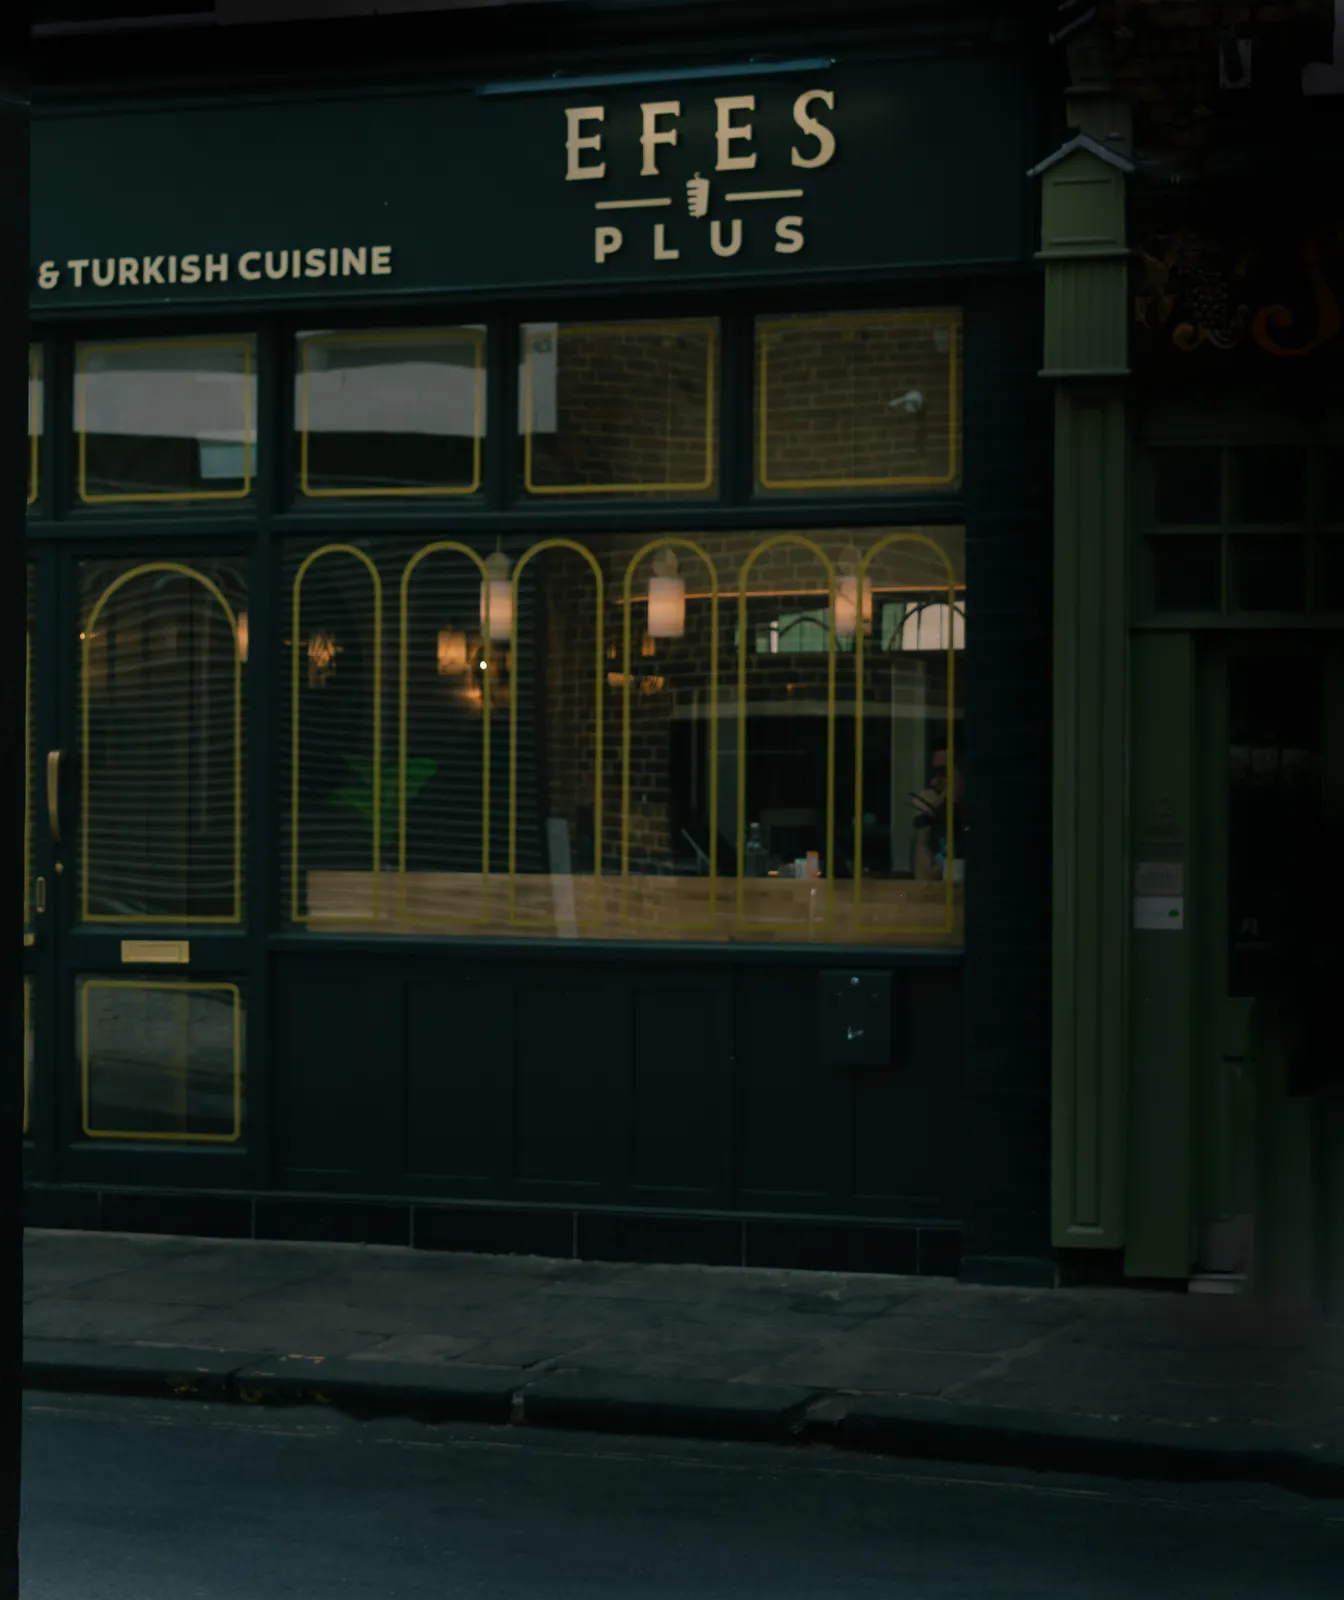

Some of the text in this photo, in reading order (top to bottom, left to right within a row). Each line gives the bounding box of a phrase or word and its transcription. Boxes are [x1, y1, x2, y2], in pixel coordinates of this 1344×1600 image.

[564, 89, 836, 181] EFES
[594, 215, 804, 264] PLUS
[37, 245, 392, 290] & TURKISH CUISINE
